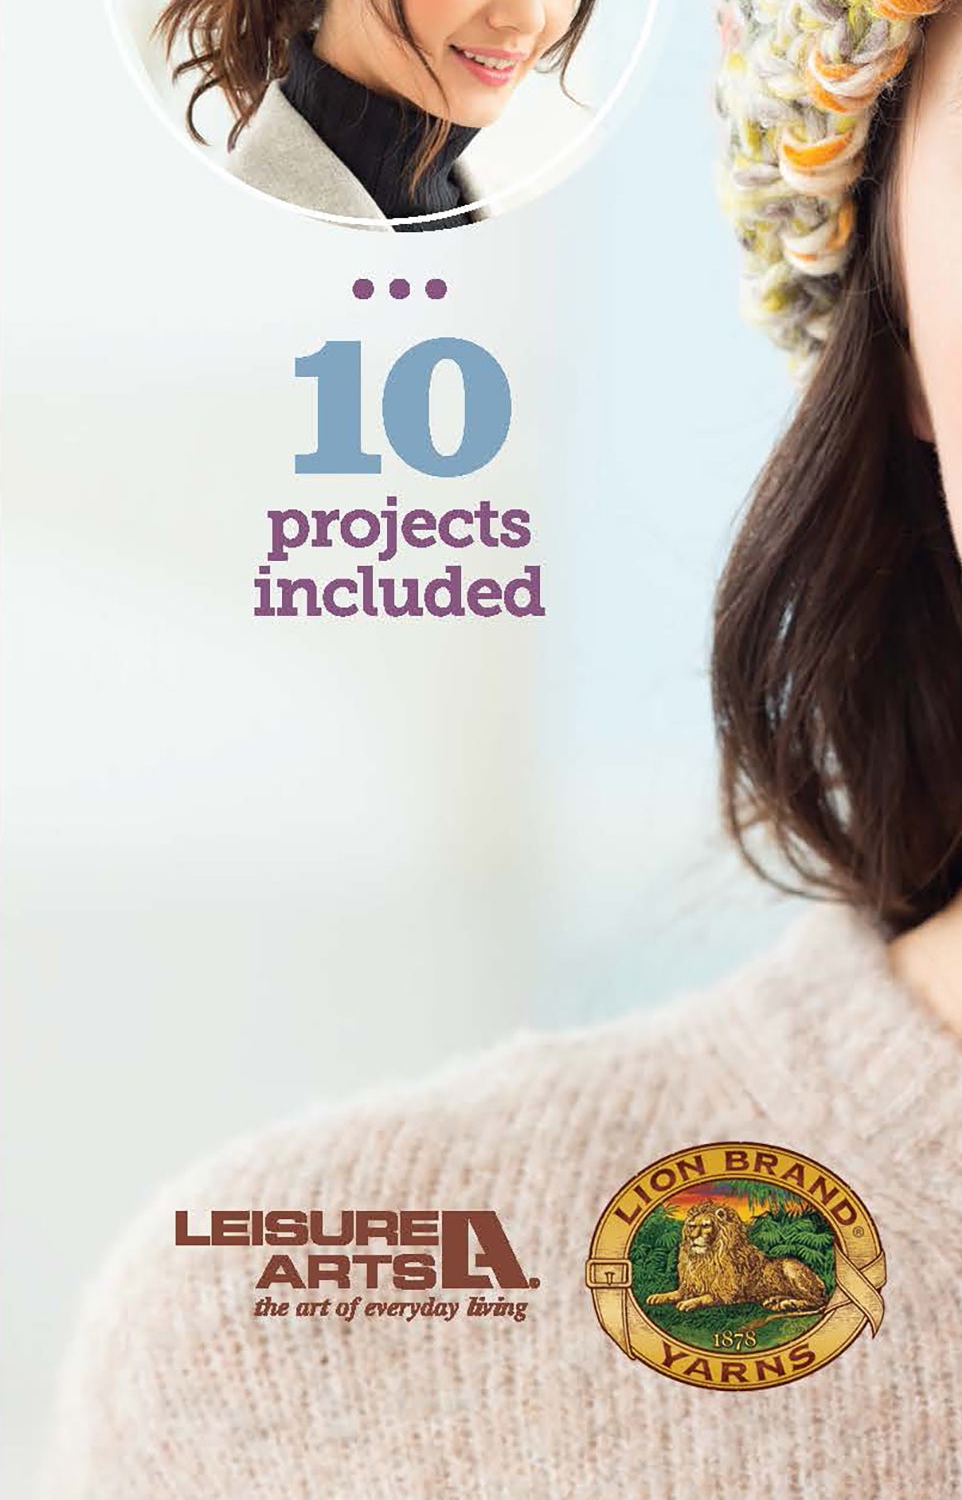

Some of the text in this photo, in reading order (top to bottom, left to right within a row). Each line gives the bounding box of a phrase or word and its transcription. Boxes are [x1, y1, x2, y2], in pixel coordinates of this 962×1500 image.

[294, 336, 512, 478] 10
[267, 496, 531, 562] projects
[253, 565, 546, 617] included
[614, 1150, 858, 1228] LION BRAND
[175, 1210, 439, 1246] LEISURE
[255, 1253, 437, 1290] ARTS
[253, 1295, 529, 1323] the art of everyday living
[711, 1330, 758, 1351] 1878
[661, 1342, 817, 1384] YARNS
